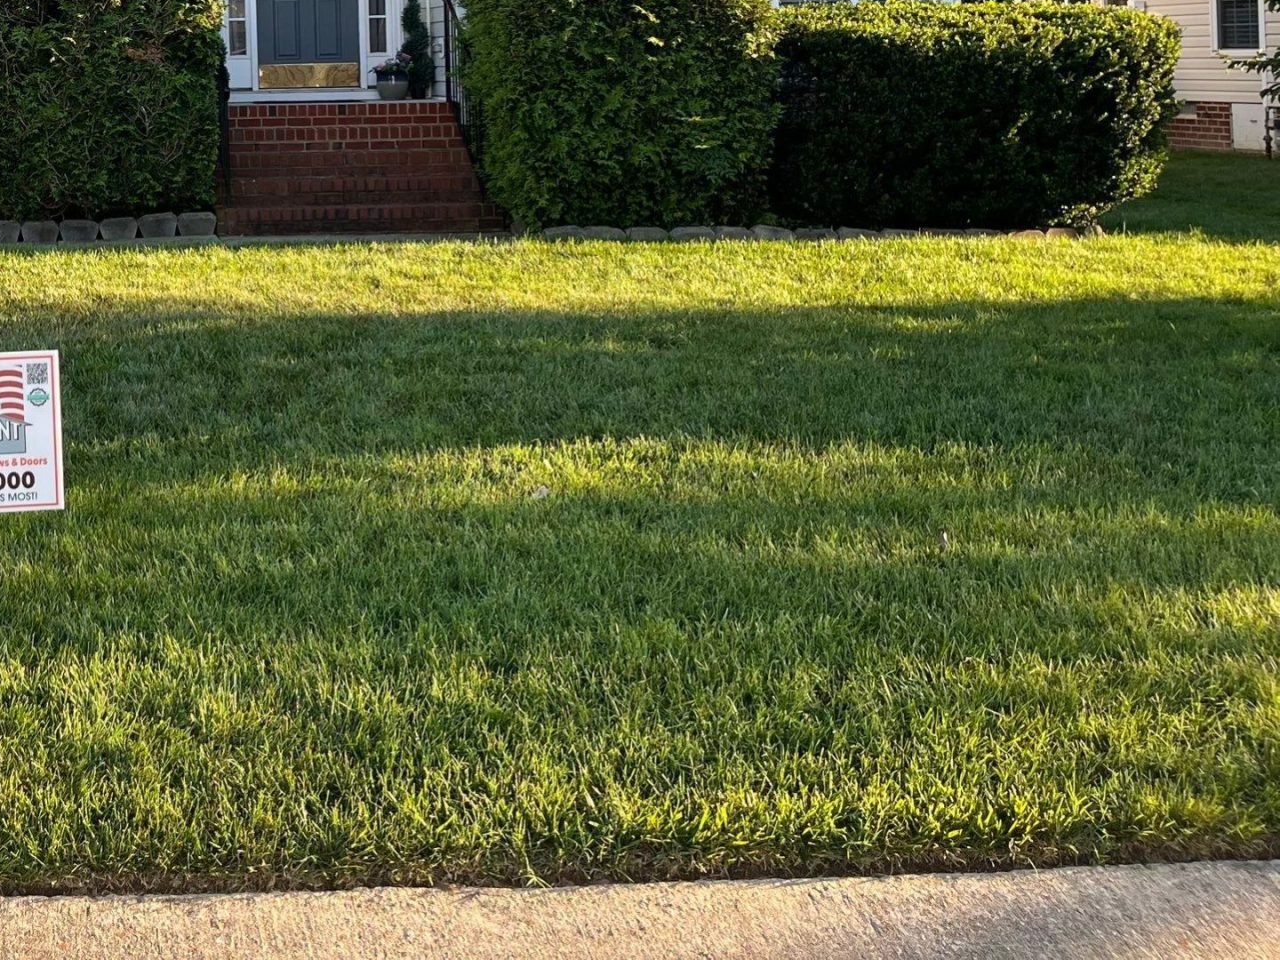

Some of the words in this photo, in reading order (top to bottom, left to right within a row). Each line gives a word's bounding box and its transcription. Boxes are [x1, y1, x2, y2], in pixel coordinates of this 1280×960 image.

[11, 457, 18, 467] &
[20, 456, 48, 466] Doors
[7, 491, 38, 502] MOST!
